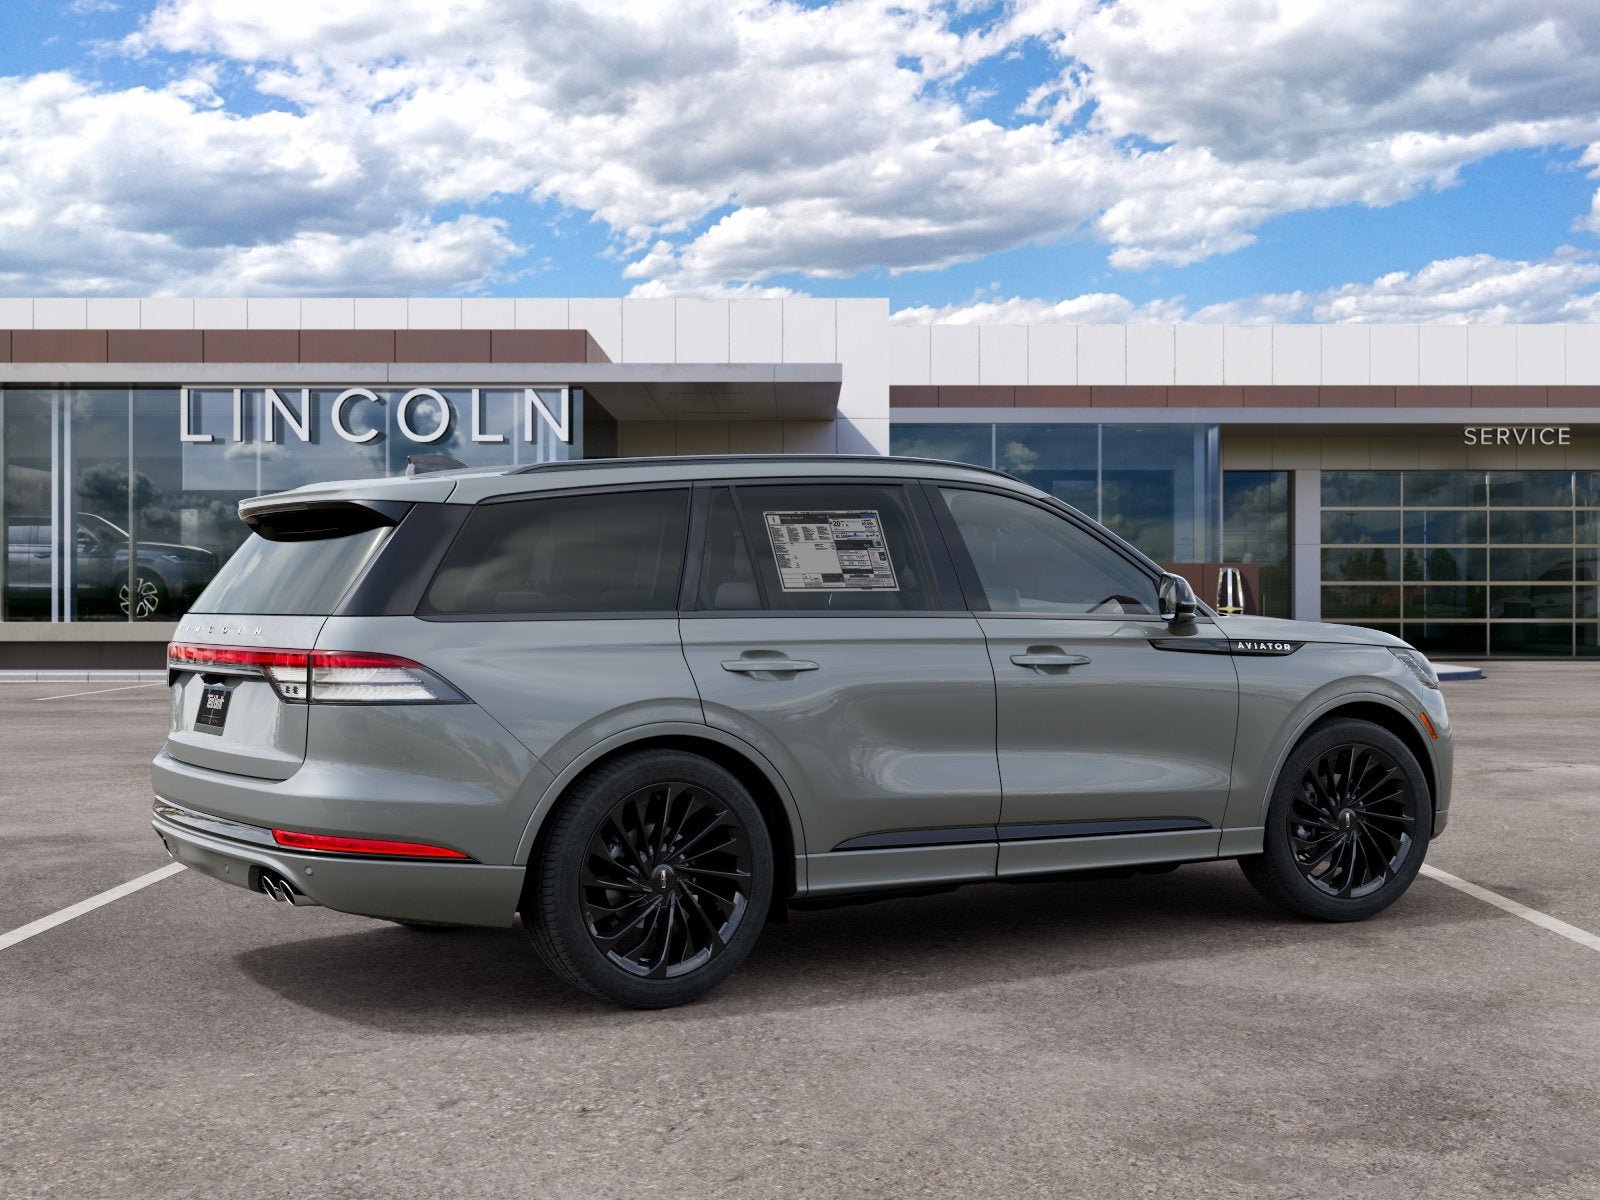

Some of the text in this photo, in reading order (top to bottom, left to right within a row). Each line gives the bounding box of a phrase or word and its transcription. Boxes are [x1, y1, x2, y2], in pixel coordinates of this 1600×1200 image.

[180, 387, 569, 443] LINCOLN
[1464, 427, 1571, 445] SERVICE
[1238, 641, 1290, 650] AVIATOR
